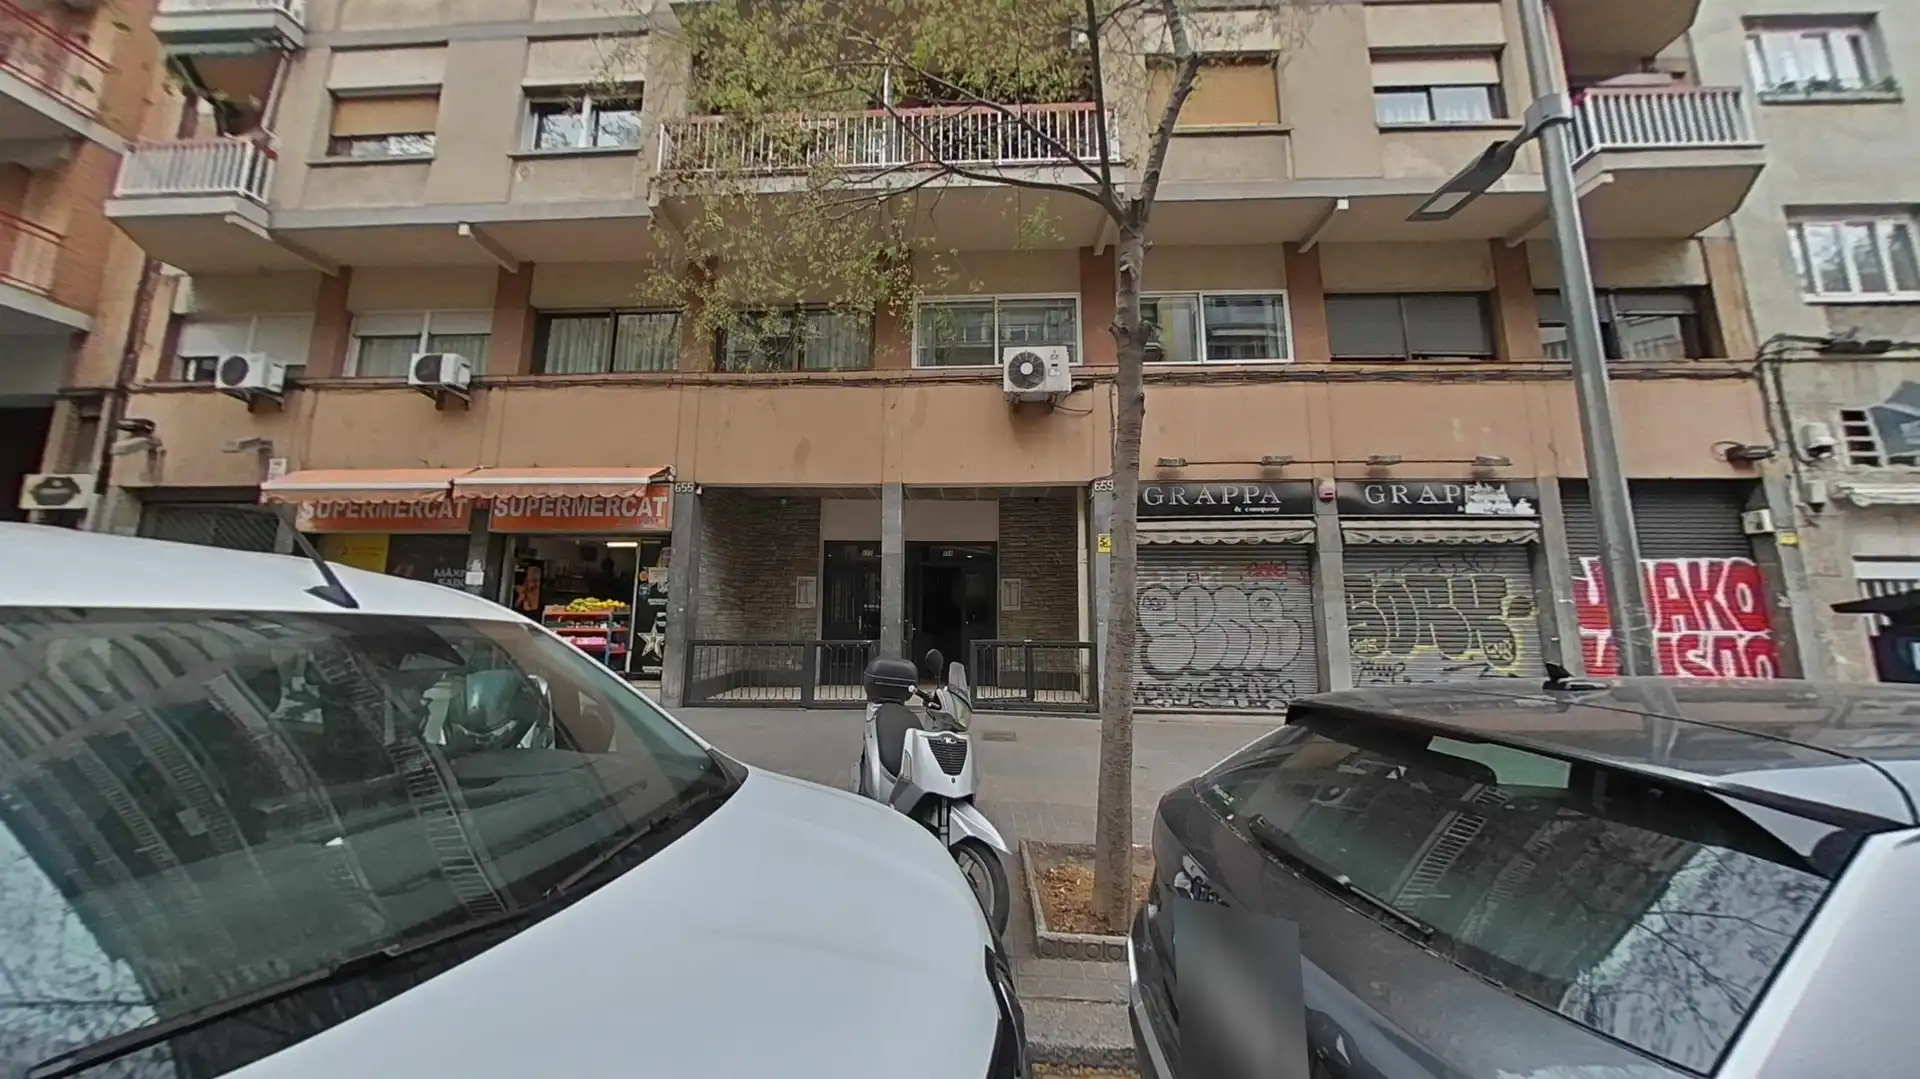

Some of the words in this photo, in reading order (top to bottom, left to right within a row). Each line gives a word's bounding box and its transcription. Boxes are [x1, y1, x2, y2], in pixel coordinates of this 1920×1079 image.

[675, 483, 694, 493] 655
[1094, 480, 1114, 490] 659
[1364, 484, 1508, 505] GRAP
[1143, 485, 1282, 505] GRAPPA
[301, 501, 468, 519] SUPERMERCAT
[494, 496, 668, 517] SUPERMERCAT
